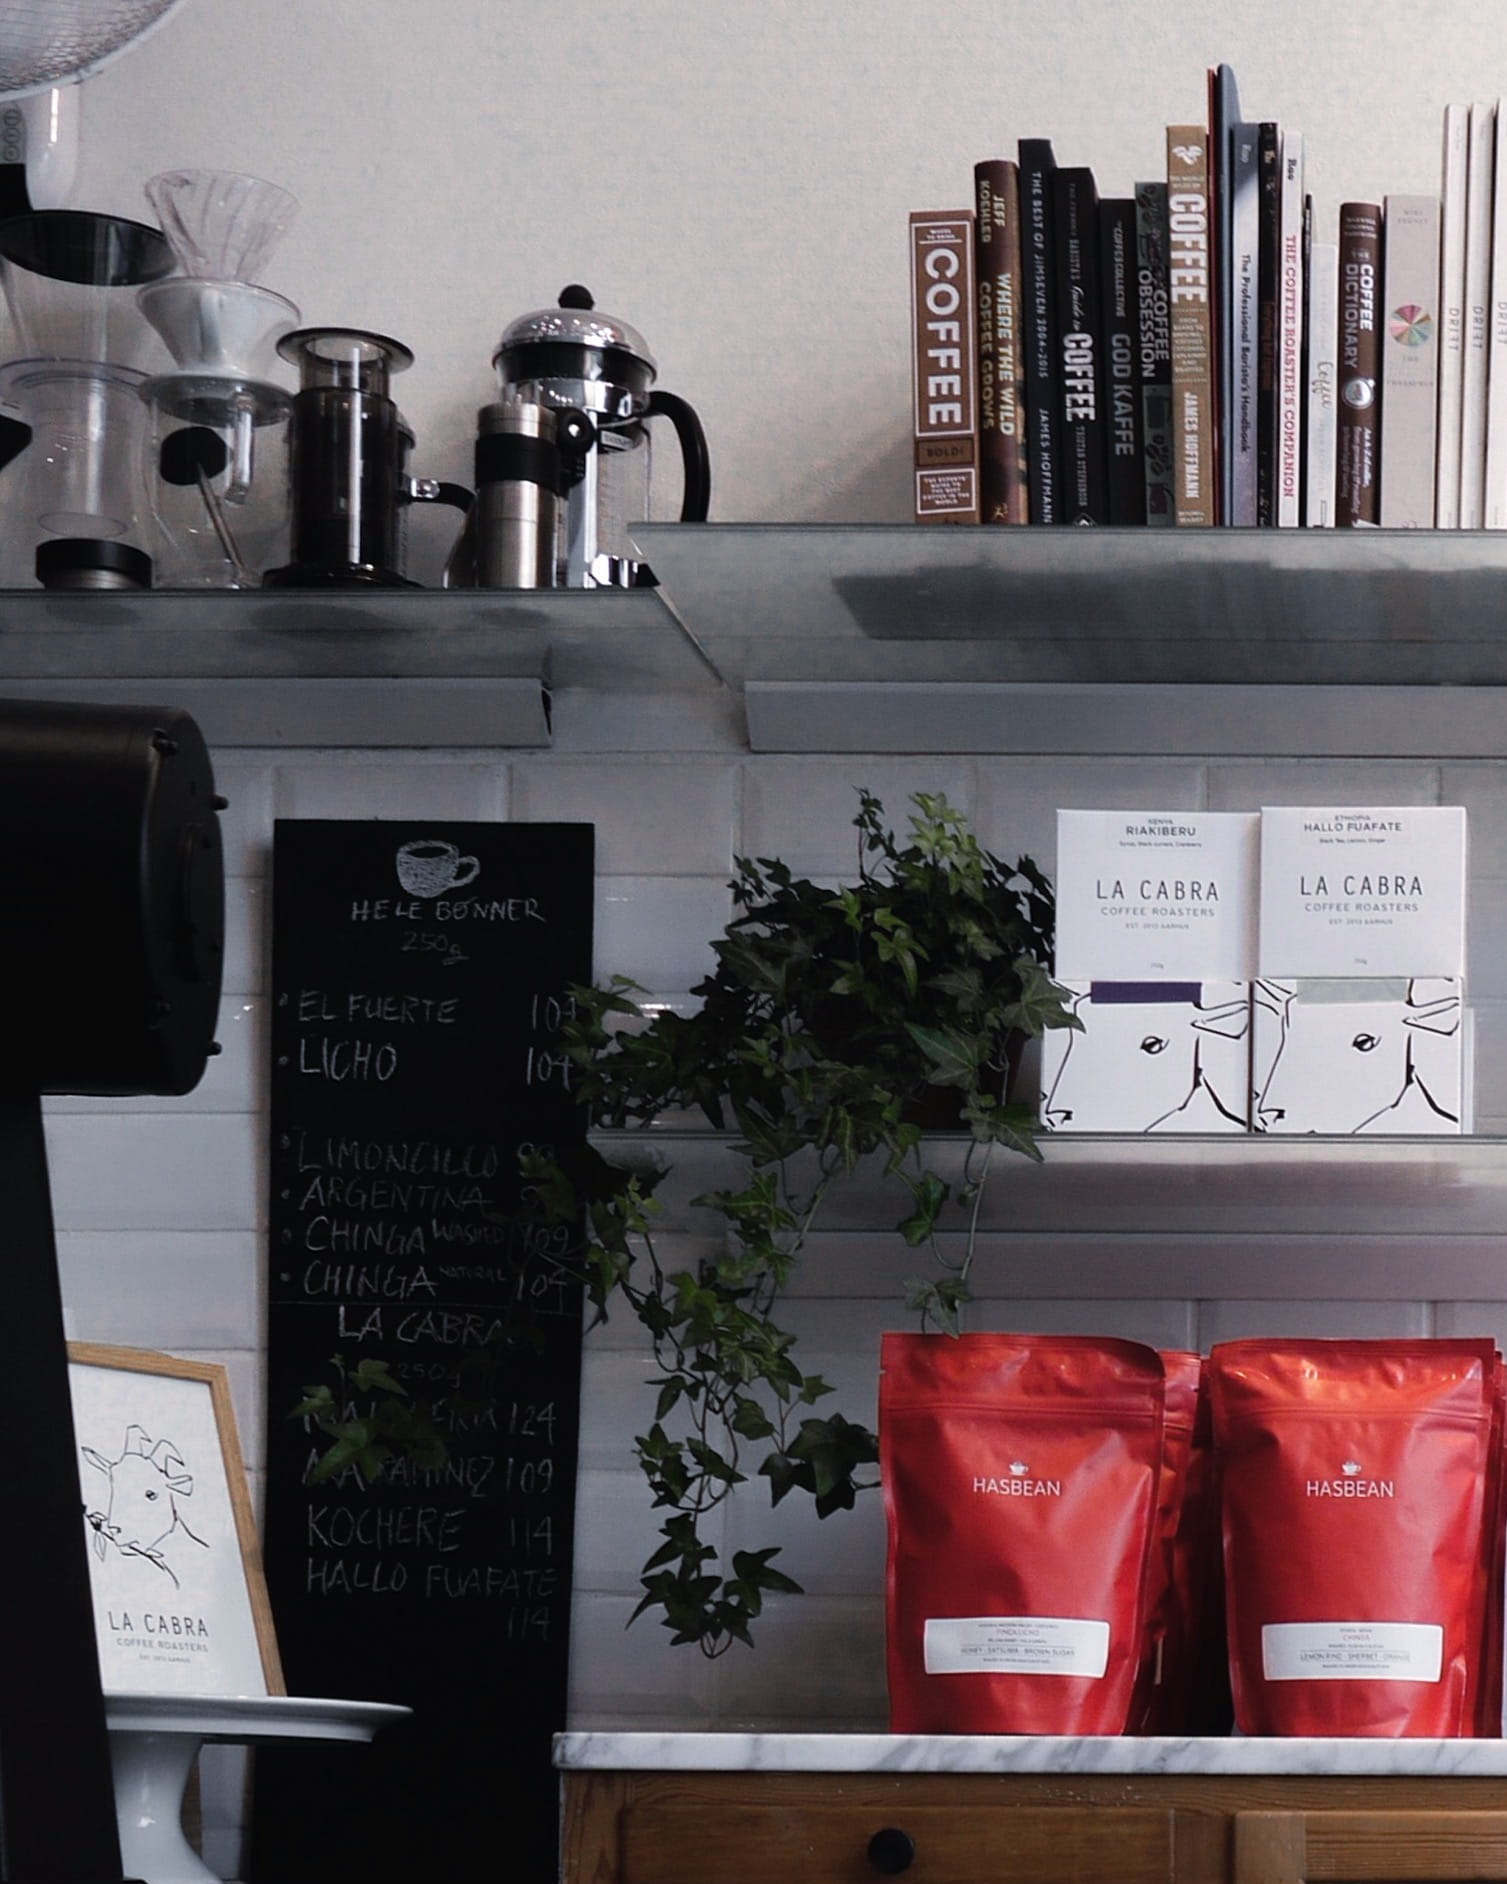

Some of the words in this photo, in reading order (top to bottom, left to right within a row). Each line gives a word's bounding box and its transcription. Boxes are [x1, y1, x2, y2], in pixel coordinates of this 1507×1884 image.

[1031, 171, 1043, 195] THE
[1287, 158, 1297, 181] Rao
[993, 194, 1006, 228] JEFF
[1032, 199, 1044, 230] BEST
[1033, 233, 1045, 250] OF
[1169, 193, 1207, 304] COFFEE
[1285, 236, 1297, 263] THE
[1241, 254, 1251, 272] The
[996, 272, 1012, 340] WHERE
[1240, 275, 1252, 343] Professional
[1284, 267, 1297, 323] COFFEE
[1345, 263, 1361, 368] DICTIONARY
[1360, 263, 1374, 330] COFFEE
[924, 247, 962, 426] COFFEE
[978, 281, 993, 355] COFFEE
[1137, 269, 1156, 378] OBSESSION
[1152, 290, 1169, 361] COFFEE
[997, 345, 1013, 382] THE
[1111, 334, 1132, 378] GOD
[1240, 346, 1252, 392] Barista's
[1283, 328, 1297, 406] ROASTER'S
[980, 359, 995, 429] GROWS
[1062, 333, 1095, 423] COFFEE
[999, 387, 1014, 436] WILD
[1038, 408, 1052, 448] JAMES
[1112, 383, 1135, 456] KAFFE
[1184, 391, 1199, 432] JAMES
[1239, 395, 1251, 453] Handbook
[1185, 434, 1200, 499] HOFFMANN
[1283, 410, 1296, 498] COMPANION
[1040, 452, 1054, 524] HOFFMANN
[1126, 825, 1196, 837] RIAKIBERU
[1304, 822, 1343, 832] HALLO
[1347, 822, 1403, 832] FUAFATE
[1096, 879, 1124, 900] LA
[1140, 880, 1219, 901] CABRA
[1300, 875, 1328, 896] LA
[1343, 875, 1423, 897] CABRA
[351, 899, 423, 922] HELE
[1101, 906, 1147, 917] COFFEE
[1152, 907, 1215, 918] ROASTERS
[1304, 902, 1351, 912] COFFEE
[1355, 902, 1419, 913] ROASTERS
[299, 988, 336, 1021] EL
[348, 993, 460, 1024] FUERTE
[299, 1036, 398, 1081] LICHO
[298, 1175, 497, 1213] ARGENTINA
[304, 1215, 426, 1256] CHINGA
[302, 1259, 439, 1300] CHINGA
[338, 1304, 384, 1342] LA
[509, 1401, 557, 1446] 124
[505, 1456, 554, 1494] 109
[973, 1477, 1061, 1498] HASBEAN
[1306, 1480, 1395, 1498] HASBEAN
[306, 1503, 469, 1553] KOCHERE
[507, 1516, 553, 1557] 114
[306, 1557, 409, 1598] HALLO
[109, 1611, 134, 1633] LA
[144, 1614, 209, 1638] CABRA
[116, 1637, 155, 1650] COFFEE
[158, 1640, 208, 1653] ROASTERS
